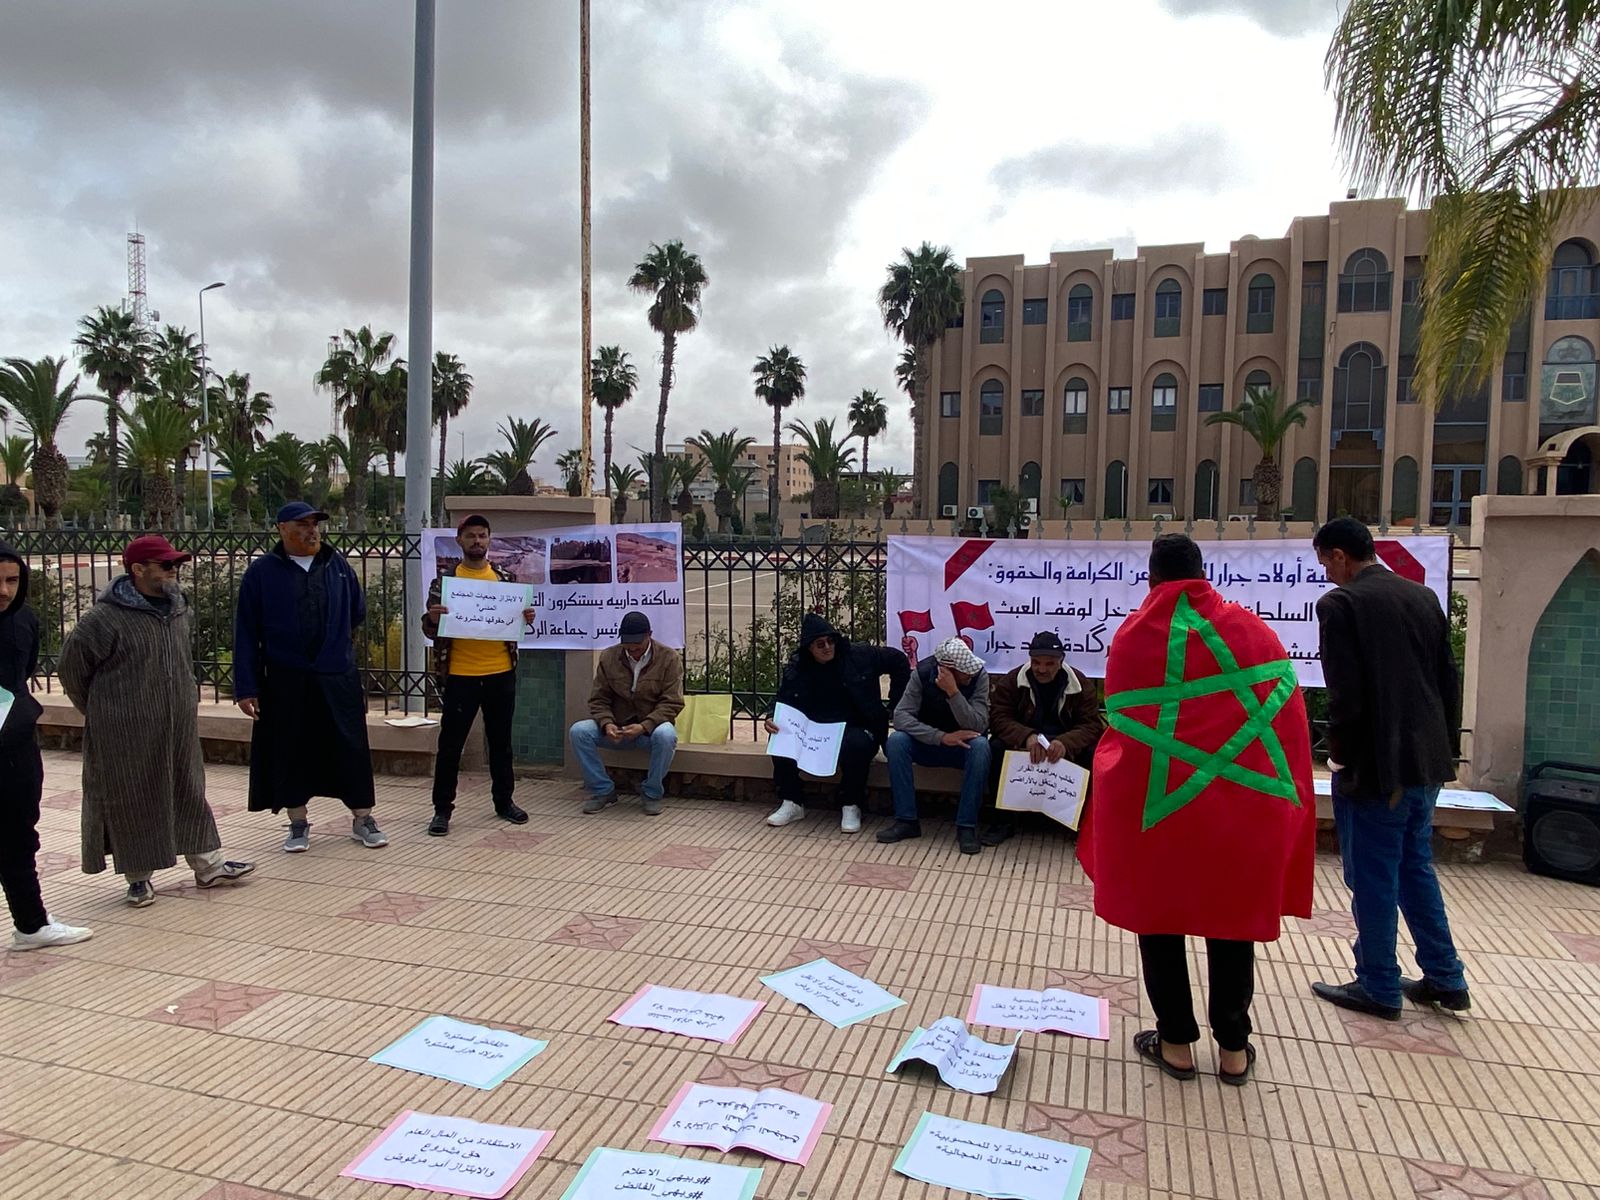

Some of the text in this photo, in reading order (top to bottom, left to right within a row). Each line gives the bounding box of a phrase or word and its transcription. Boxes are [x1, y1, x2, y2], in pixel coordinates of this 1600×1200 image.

[1066, 561, 1123, 585] الكرامة
[1215, 563, 1252, 588] جرار
[1257, 556, 1303, 588] أولاد
[547, 591, 605, 611] يستنكرون
[641, 589, 680, 606] ساكنة
[995, 596, 1040, 619] العبث
[1045, 597, 1092, 622] لوقف
[549, 620, 588, 639] جماعة
[984, 630, 1016, 654] جرار
[461, 1150, 481, 1159] حق
